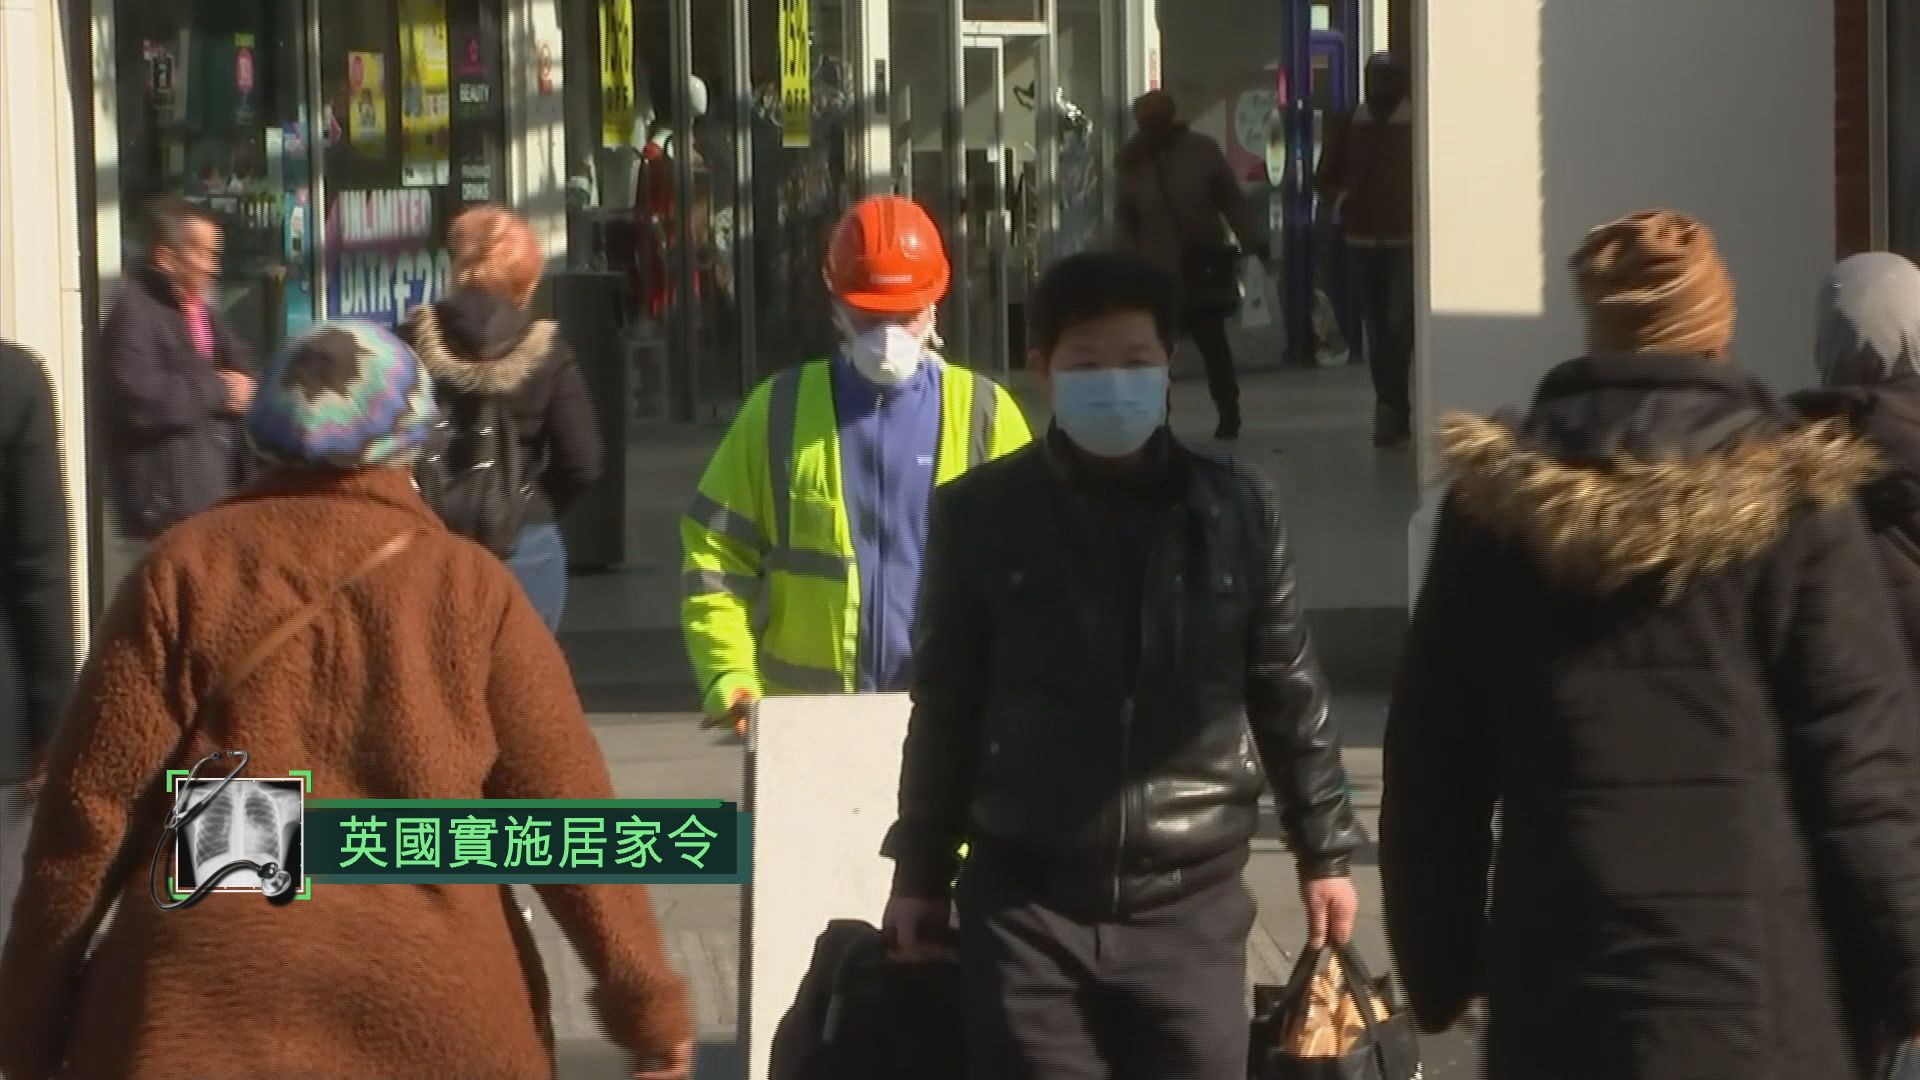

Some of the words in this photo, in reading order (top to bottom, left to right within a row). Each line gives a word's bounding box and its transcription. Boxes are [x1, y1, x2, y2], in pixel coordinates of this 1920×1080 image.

[459, 83, 490, 103] BEAUTY
[786, 88, 806, 112] OFF
[339, 189, 432, 241] UNLIMITED
[340, 250, 392, 314] DATA
